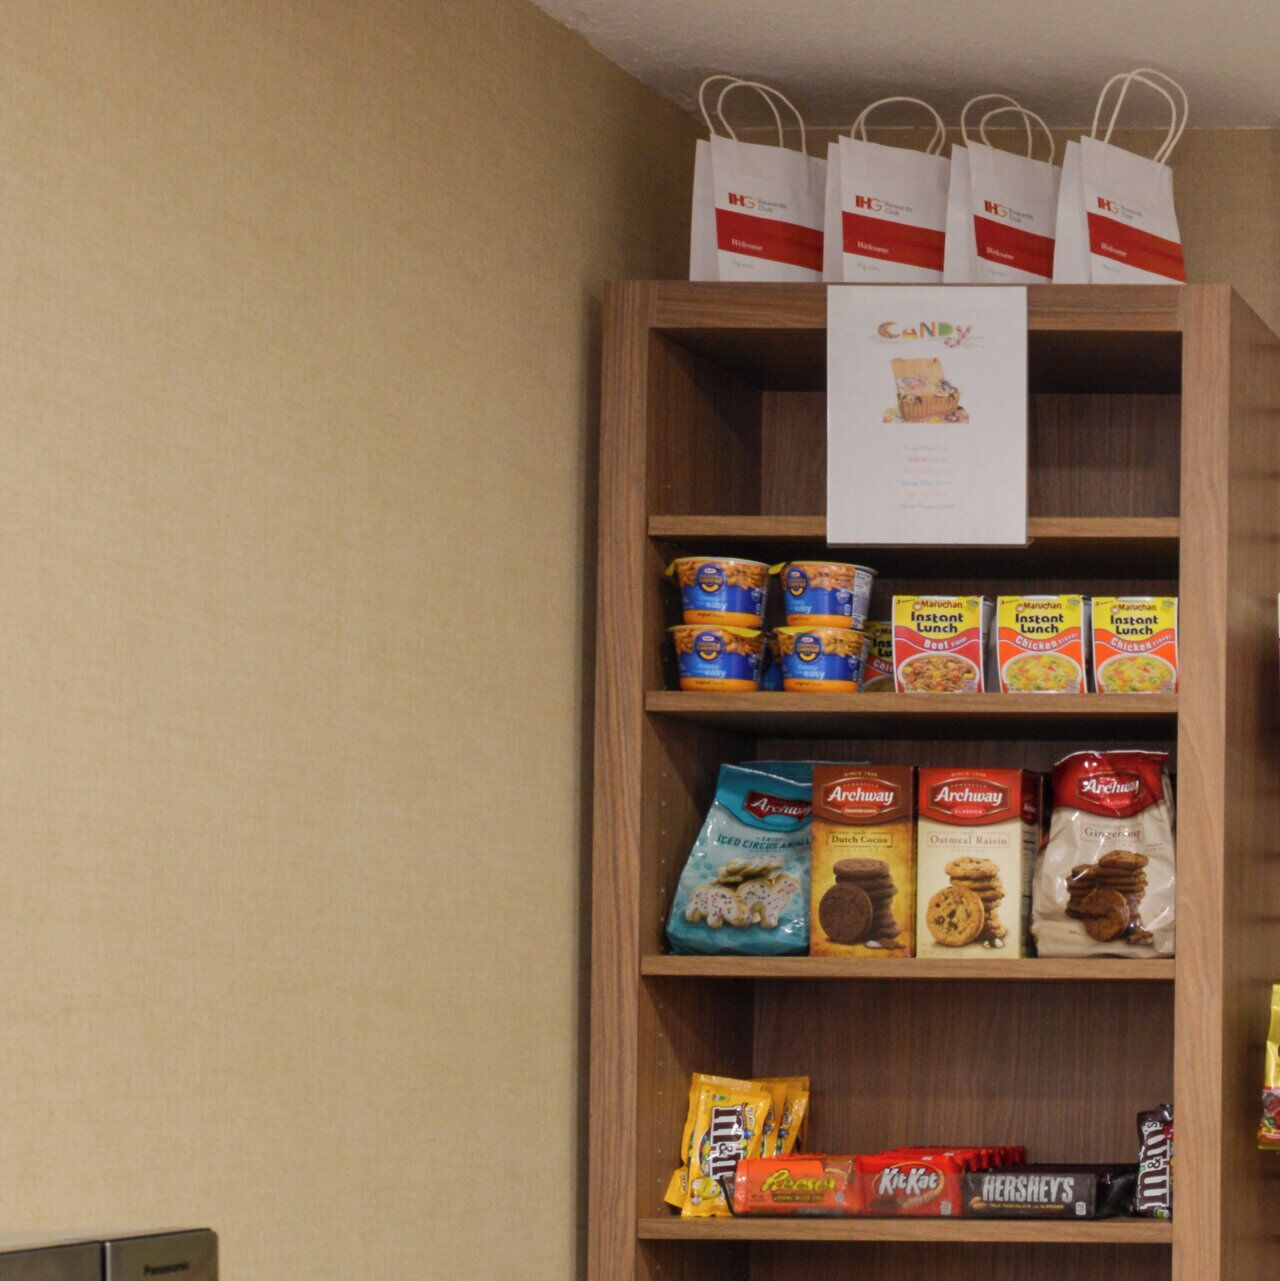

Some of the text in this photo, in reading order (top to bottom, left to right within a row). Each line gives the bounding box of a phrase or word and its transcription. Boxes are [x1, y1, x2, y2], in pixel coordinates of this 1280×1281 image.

[728, 192, 755, 209] IHG
[855, 195, 882, 212] IHG
[1097, 196, 1119, 214] IHG
[984, 200, 1007, 217] IHG
[920, 600, 963, 609] Maruchan
[1023, 601, 1062, 610] Maruchan
[1118, 603, 1156, 612] Maruchan
[911, 611, 964, 623] Instant
[1015, 613, 1064, 624] Instant
[1110, 615, 1158, 625] Instant
[916, 623, 958, 633] Lunch
[1020, 624, 1059, 634] Lunch
[1115, 625, 1153, 635] Lunch
[924, 639, 949, 650] Beef
[1015, 636, 1058, 651] Chicken
[1110, 638, 1151, 652] Chicken
[1081, 779, 1140, 795] Archway
[827, 786, 894, 805] Archway
[935, 786, 1003, 806] Archway
[832, 835, 858, 844] Dutch
[930, 835, 1008, 845] Oatmeal Raisin
[982, 1175, 1075, 1203] HERSHEY'S
